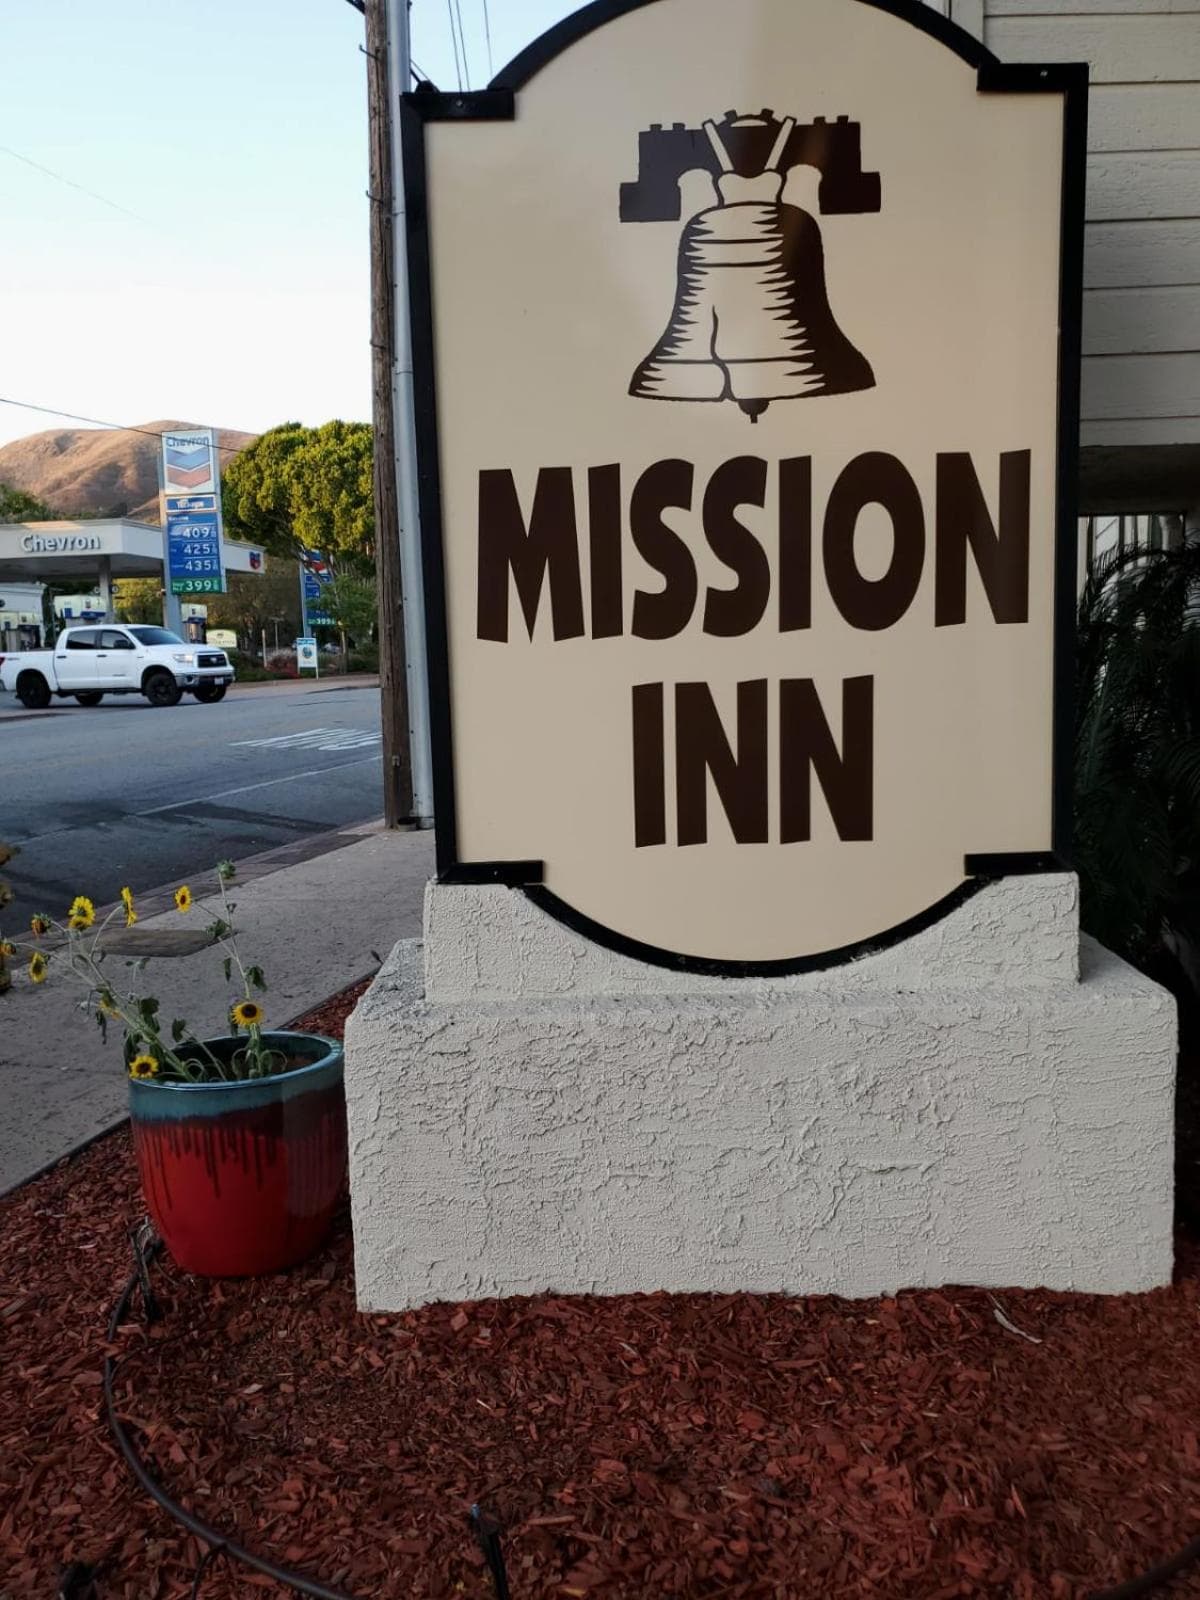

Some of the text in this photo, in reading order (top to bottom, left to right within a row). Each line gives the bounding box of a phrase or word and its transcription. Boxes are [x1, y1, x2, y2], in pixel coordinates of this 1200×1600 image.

[166, 435, 209, 448] Chevron
[182, 527, 210, 538] 409
[21, 534, 101, 552] Chevron
[183, 544, 210, 554] 425
[477, 449, 1031, 643] MISSION
[185, 560, 211, 571] 435
[186, 581, 212, 591] 399
[632, 675, 874, 848] INN
